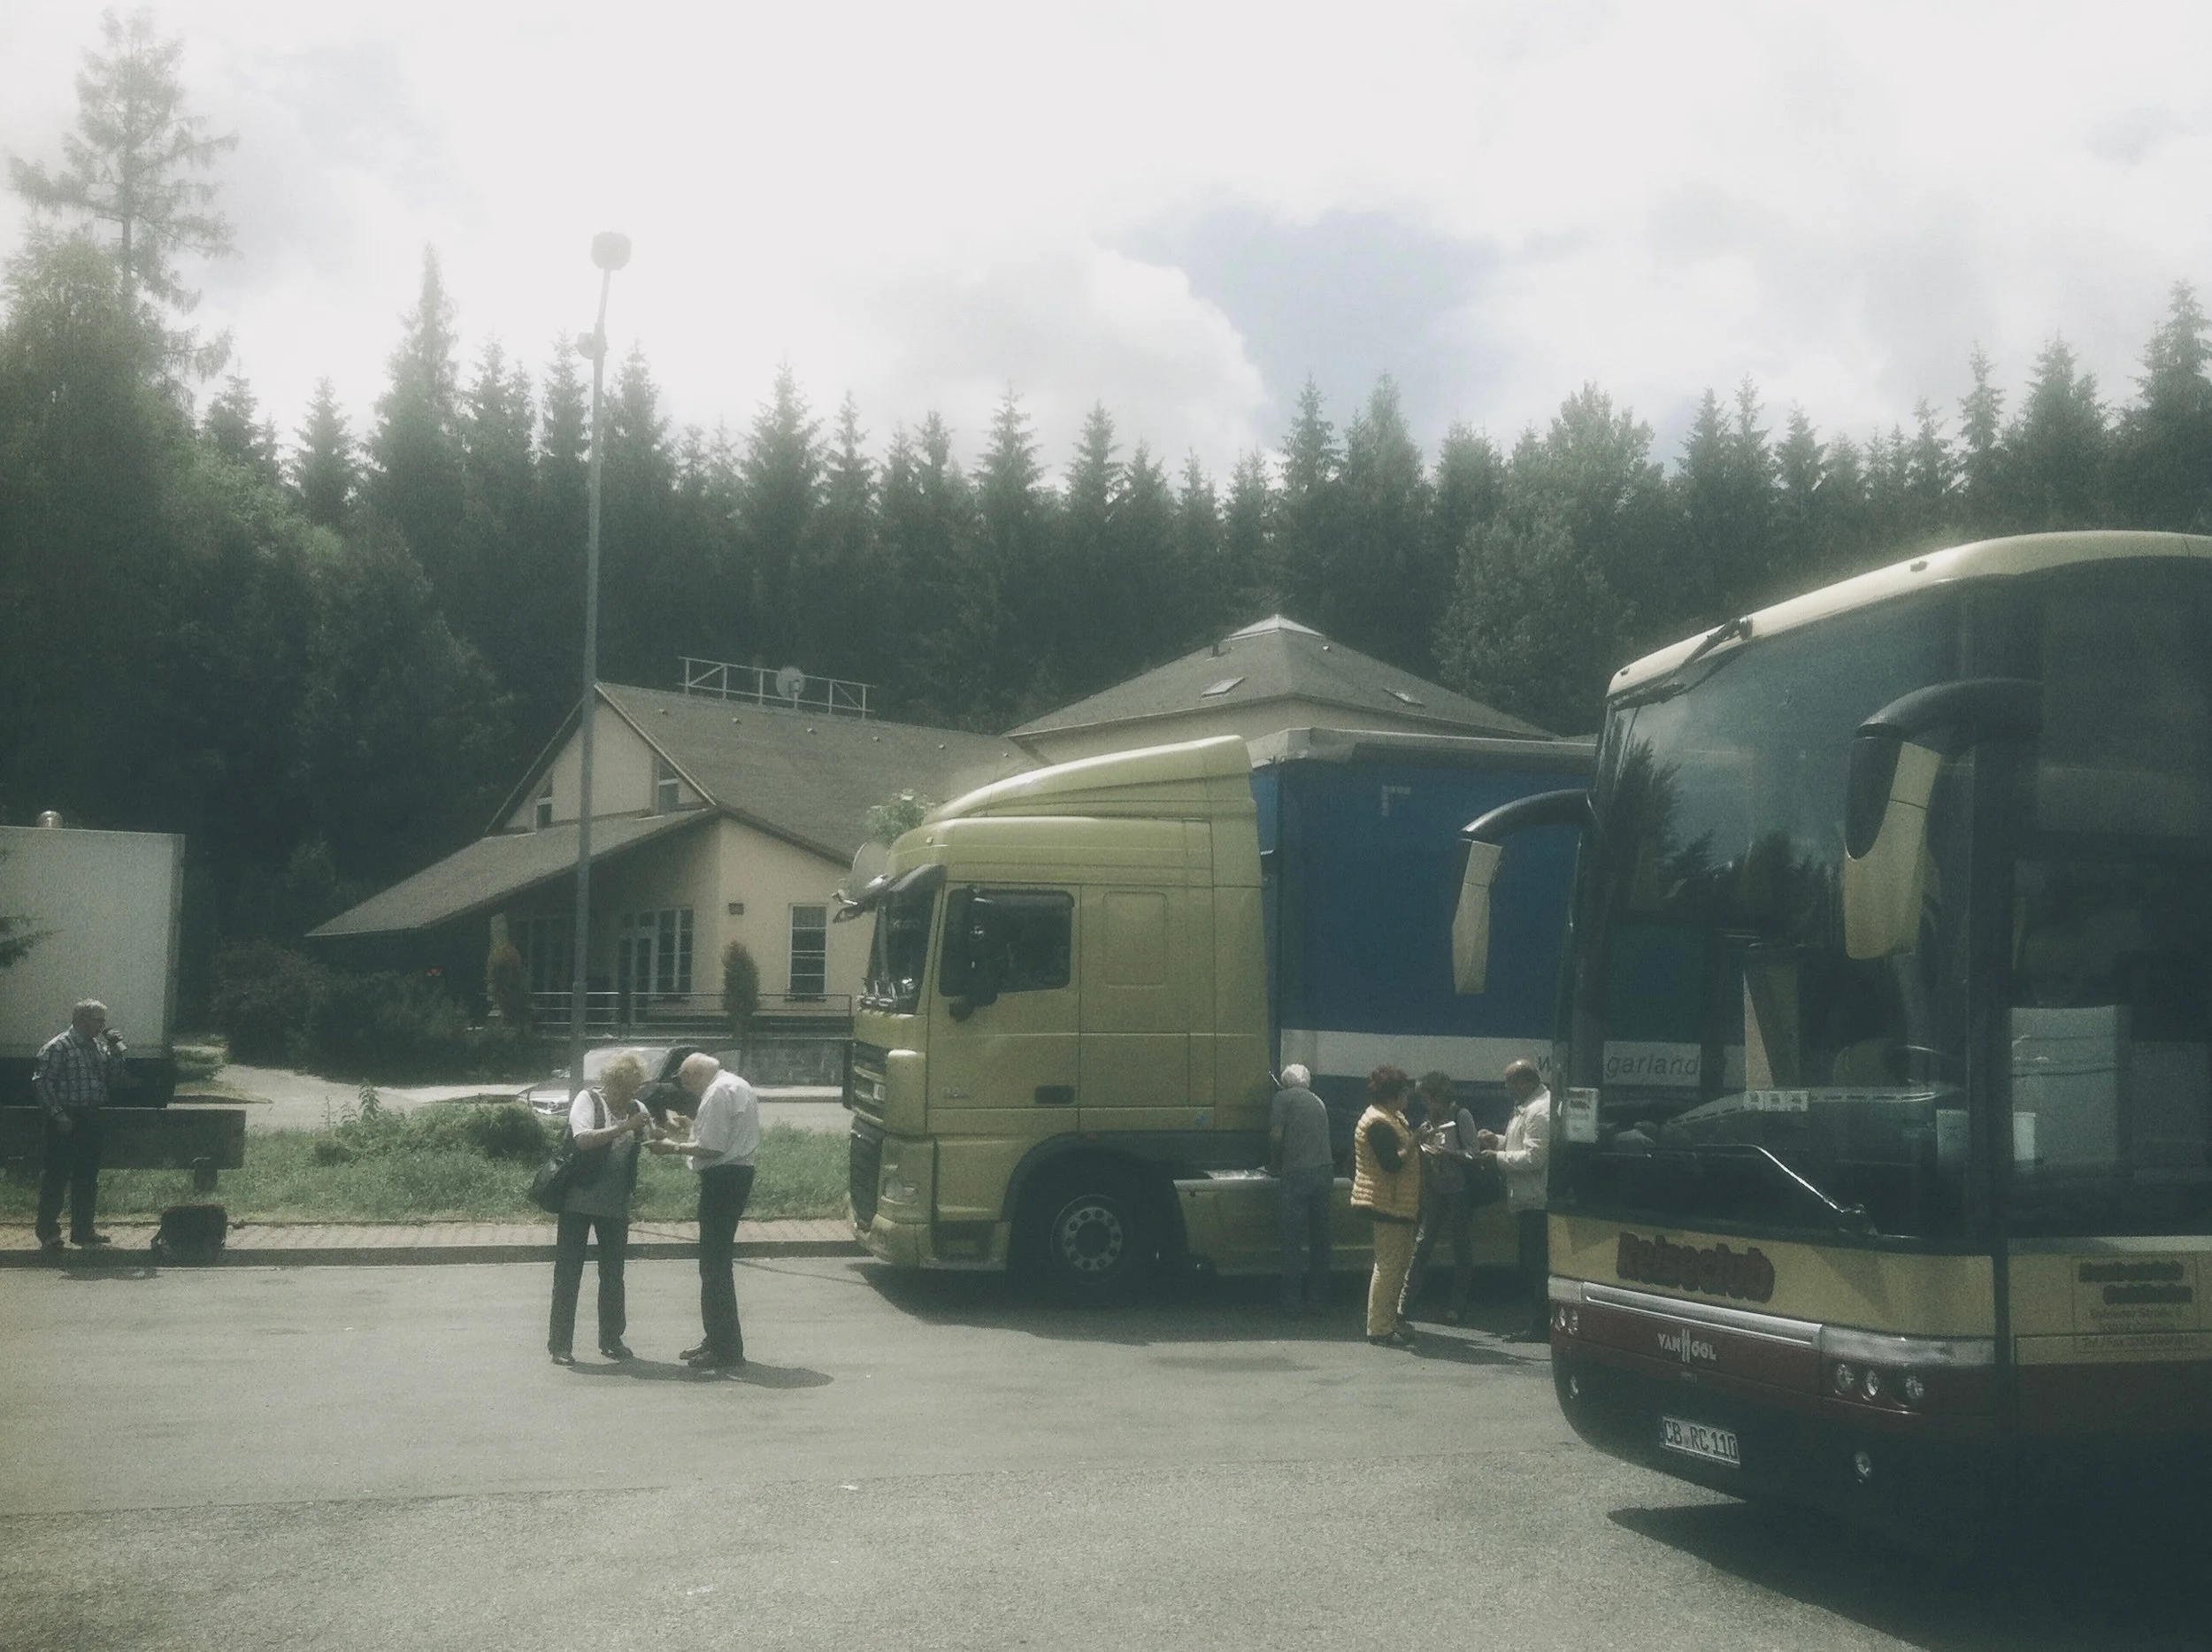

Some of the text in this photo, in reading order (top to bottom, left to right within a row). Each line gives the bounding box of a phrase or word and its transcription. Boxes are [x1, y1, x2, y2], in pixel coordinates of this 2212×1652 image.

[1617, 1231, 1775, 1303] Reiseclub
[1663, 1420, 1739, 1460] CB RC 110
